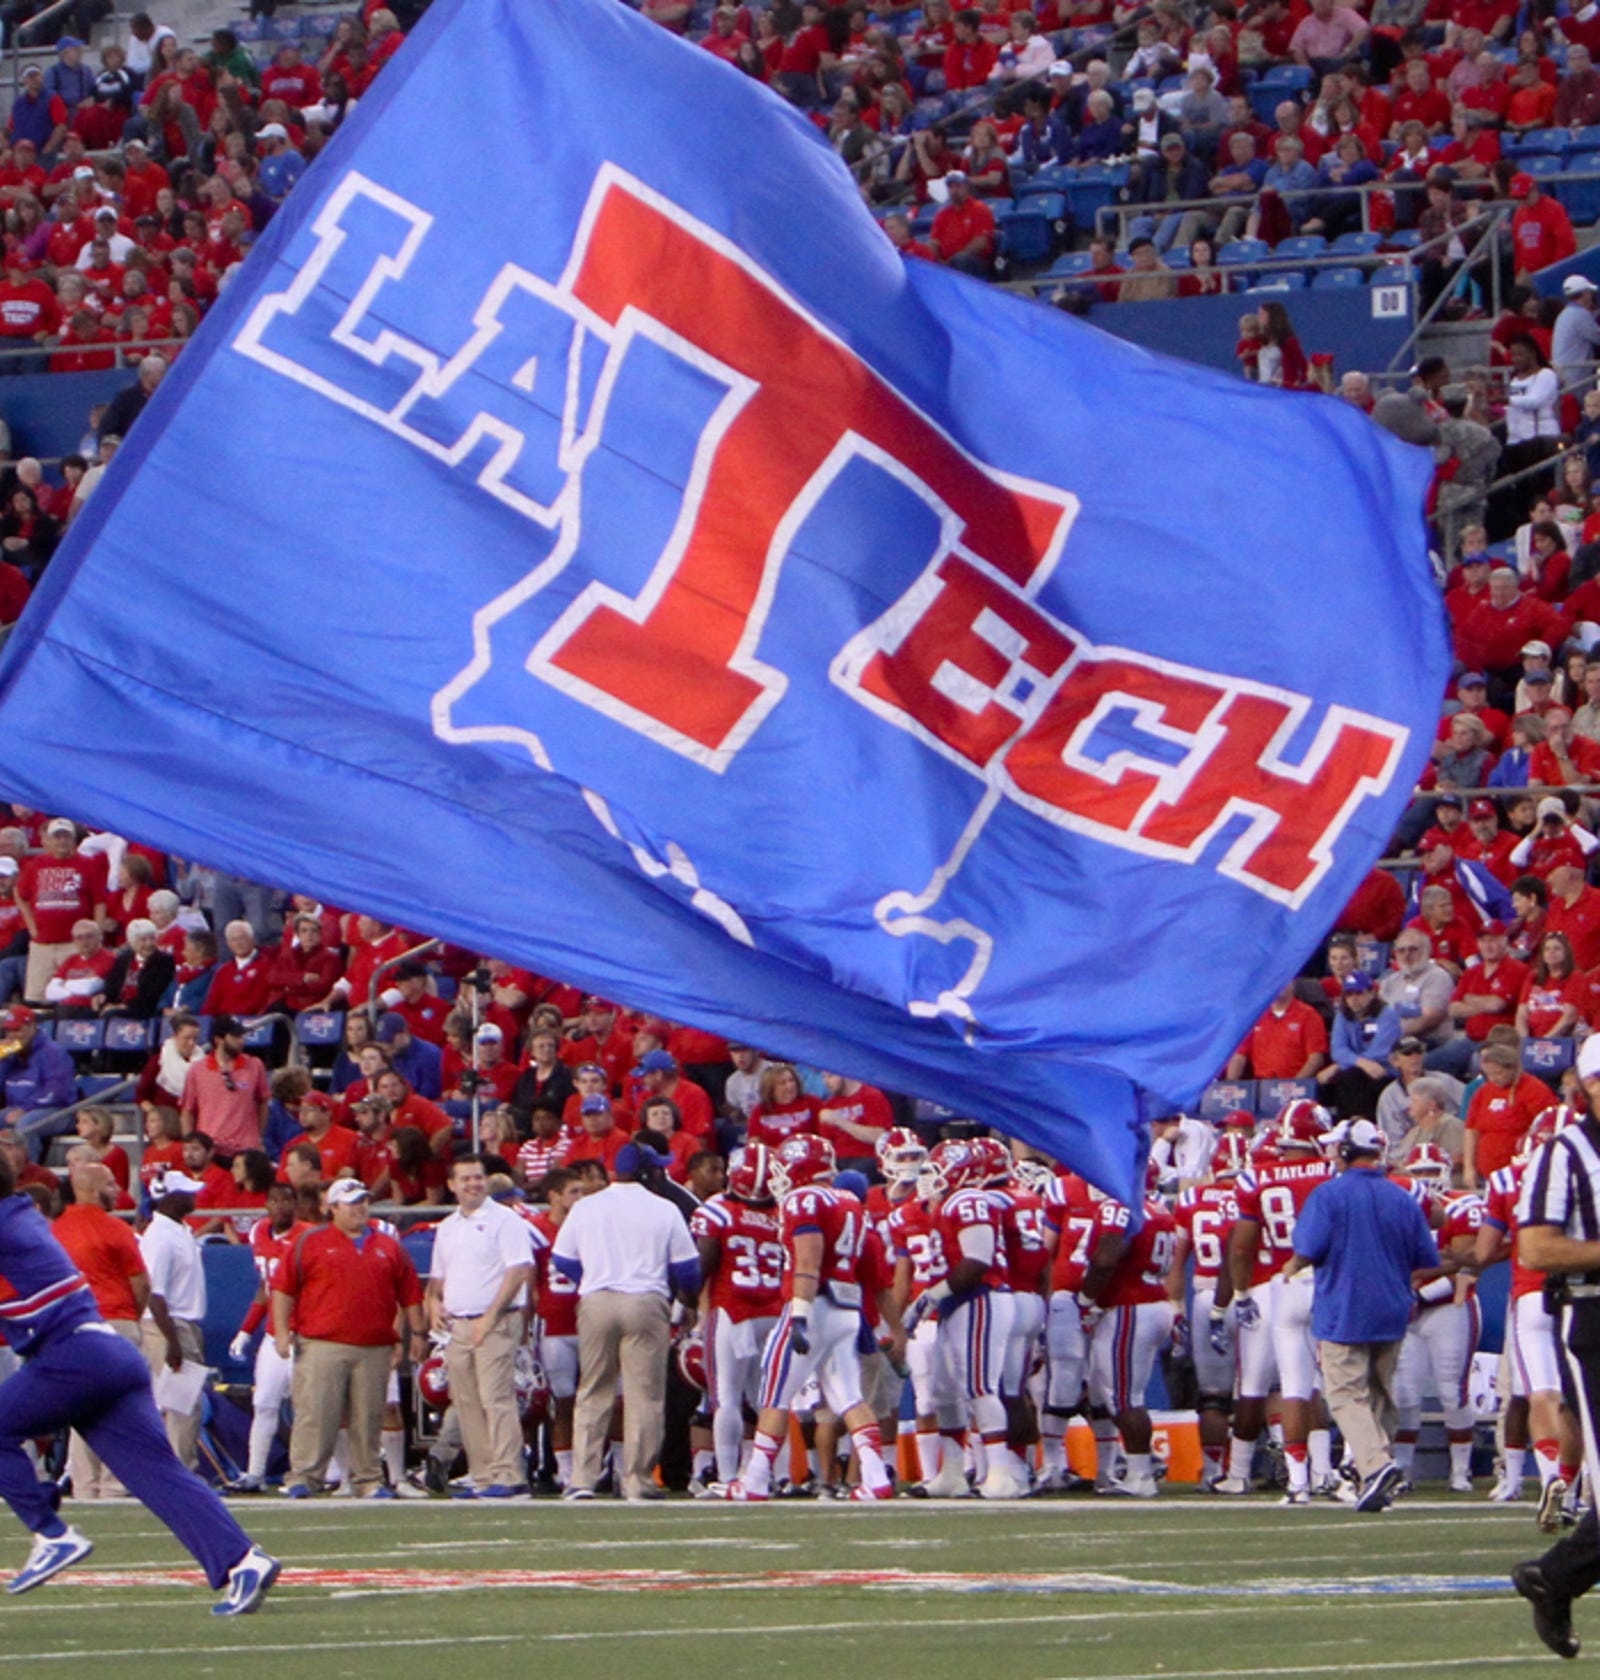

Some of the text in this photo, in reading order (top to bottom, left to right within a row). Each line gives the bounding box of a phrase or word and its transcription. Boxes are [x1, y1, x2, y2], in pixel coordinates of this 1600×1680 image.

[231, 169, 597, 530] LA
[1274, 1161, 1325, 1181] TAYLOR
[786, 1193, 817, 1216] 44
[1101, 1204, 1131, 1228] 96
[726, 1234, 785, 1288] 33
[1151, 1429, 1170, 1460] G
